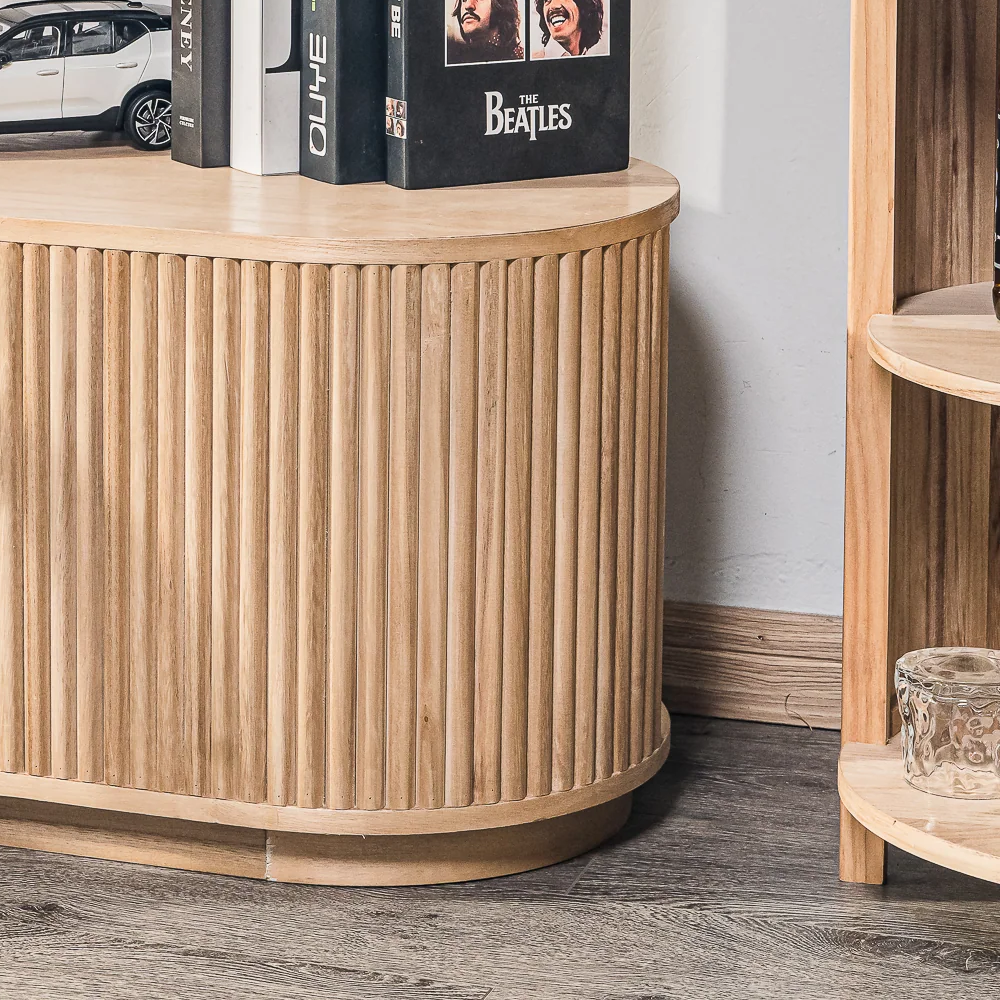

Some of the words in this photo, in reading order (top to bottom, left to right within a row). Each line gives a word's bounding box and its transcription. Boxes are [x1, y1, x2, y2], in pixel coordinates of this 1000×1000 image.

[390, 4, 402, 39] BE
[308, 32, 327, 157] OUYE
[519, 93, 540, 104] THE
[484, 91, 573, 141] BEATLES
